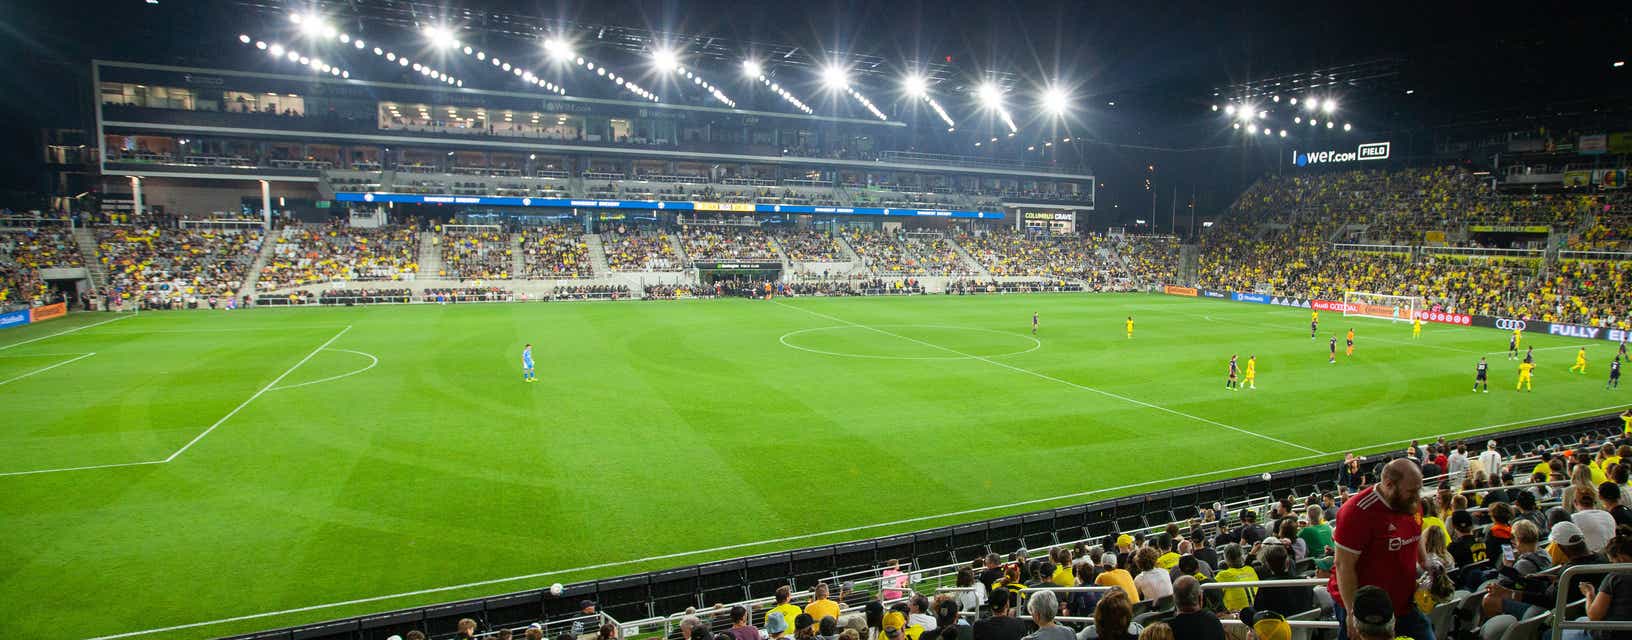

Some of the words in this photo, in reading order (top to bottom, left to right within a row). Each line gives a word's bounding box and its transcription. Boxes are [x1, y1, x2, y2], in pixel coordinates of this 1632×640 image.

[1362, 147, 1385, 156] FIELD
[1025, 212, 1054, 220] COLUMBUS
[1550, 324, 1599, 338] FULLY
